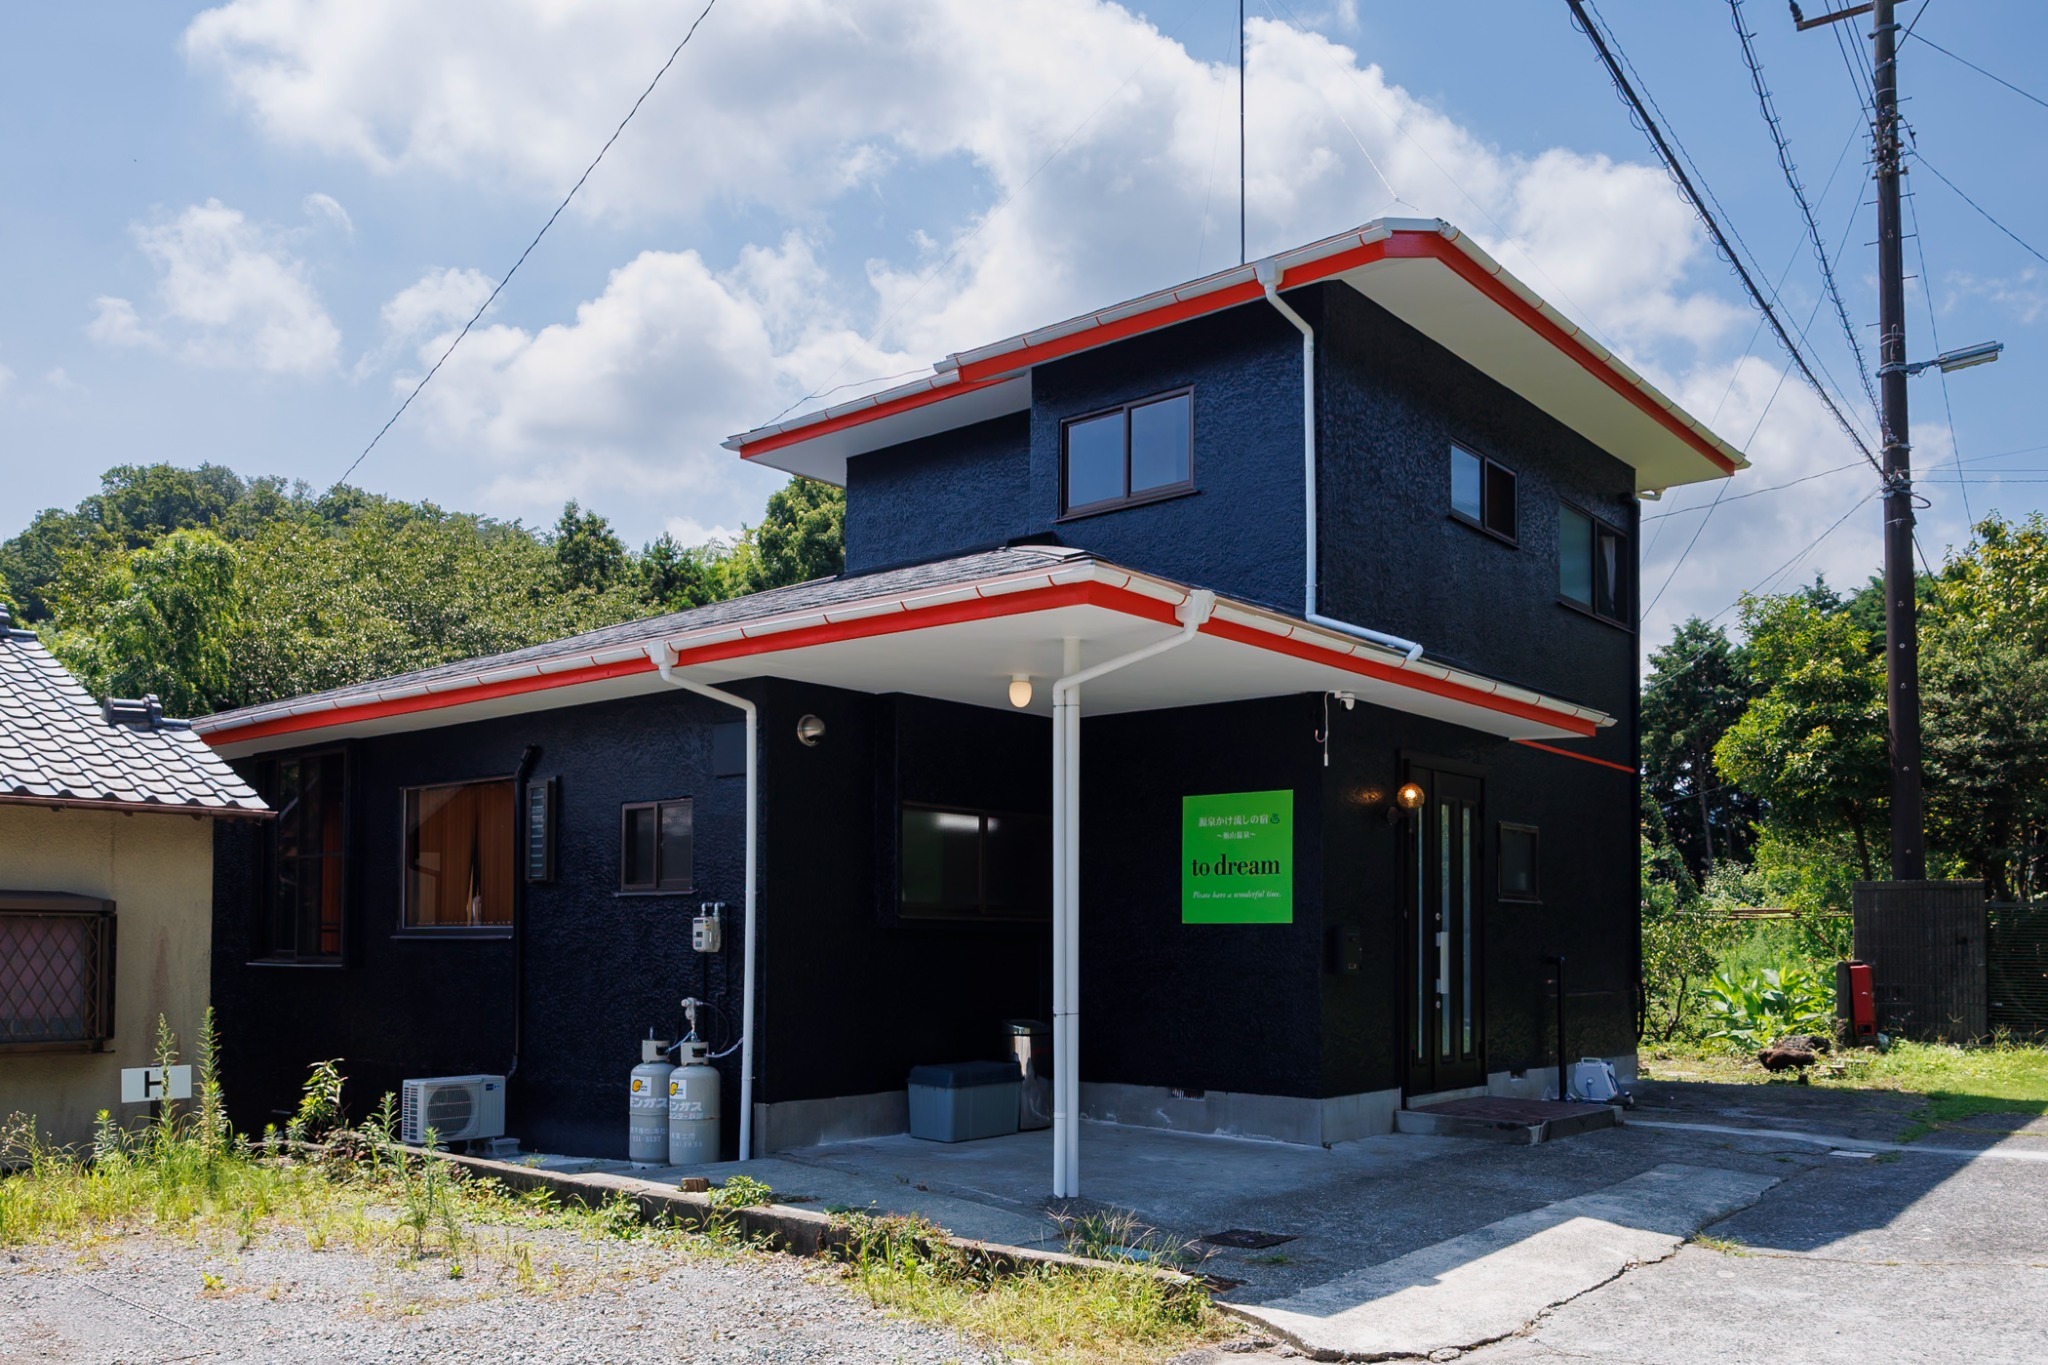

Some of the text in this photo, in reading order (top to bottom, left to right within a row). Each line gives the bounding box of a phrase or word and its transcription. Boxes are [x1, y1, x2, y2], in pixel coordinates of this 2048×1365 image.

[1192, 853, 1280, 877] to dream
[1233, 889, 1265, 900] wonderful
